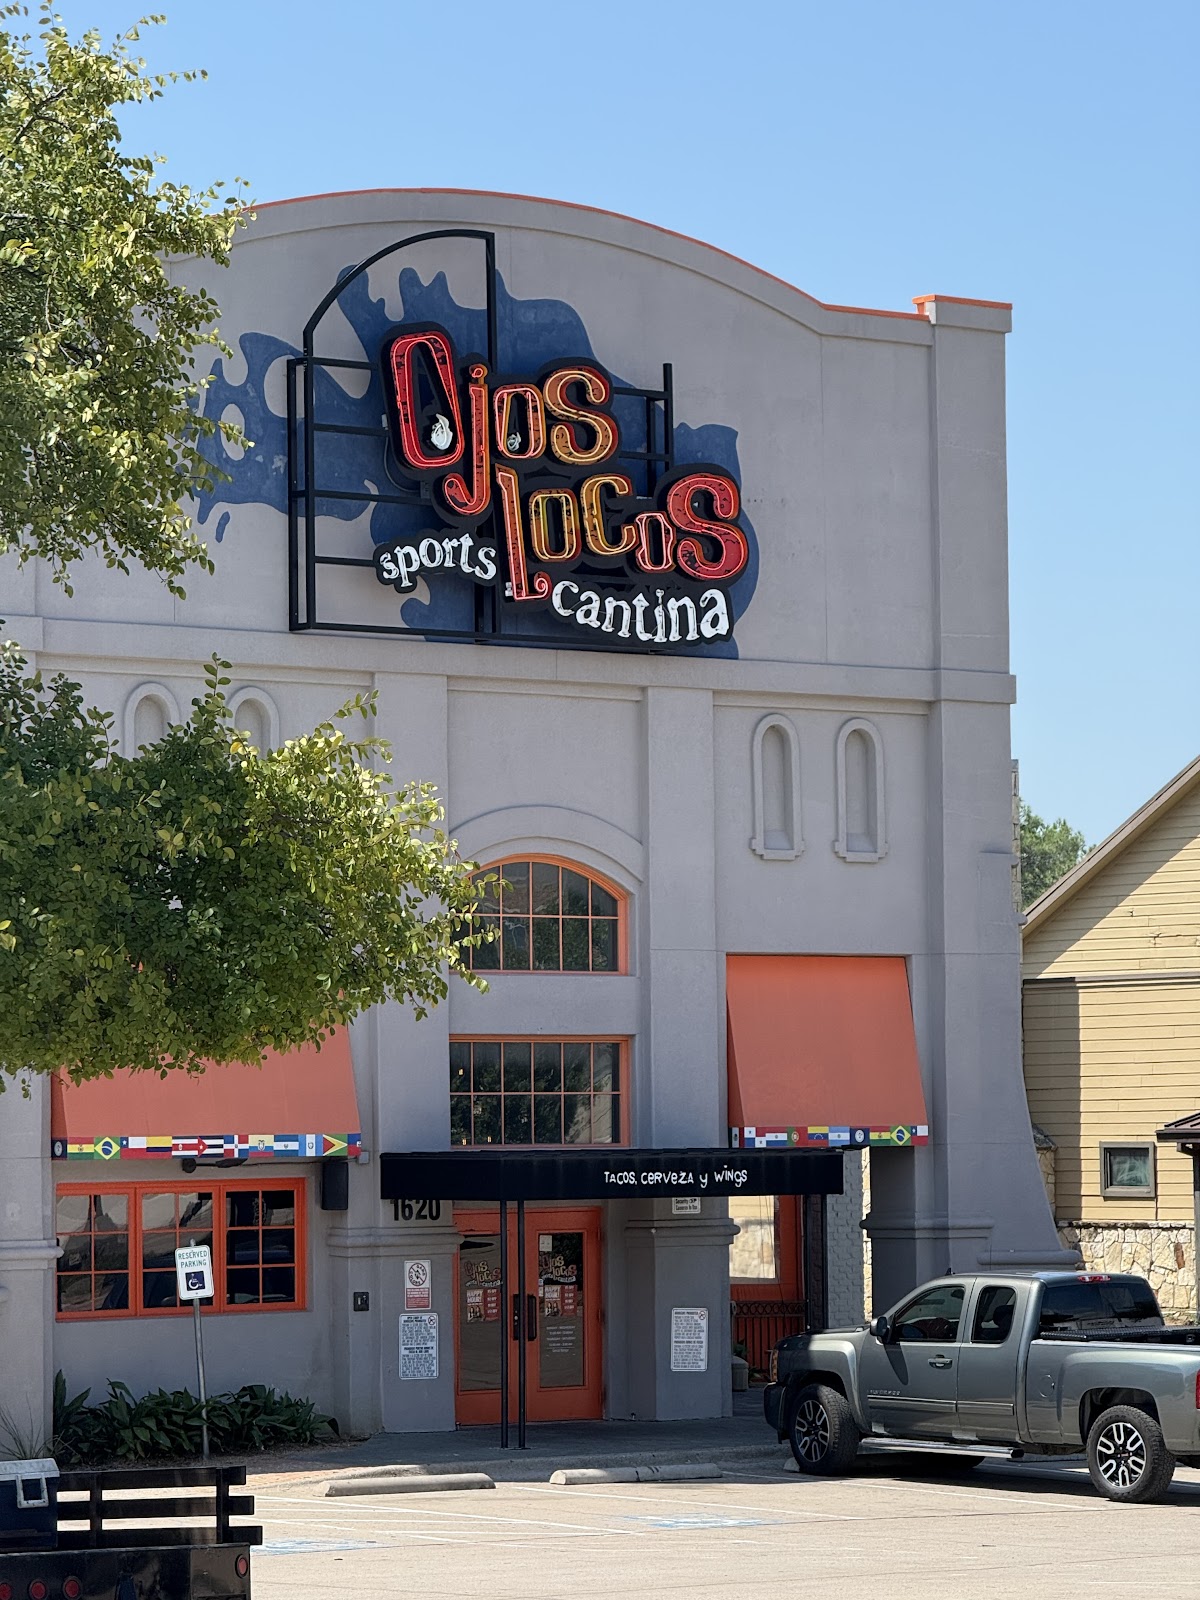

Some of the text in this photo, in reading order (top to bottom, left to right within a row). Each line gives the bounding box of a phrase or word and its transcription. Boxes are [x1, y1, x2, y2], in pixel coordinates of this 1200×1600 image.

[390, 330, 619, 516] Ojos
[378, 533, 497, 588] sports
[551, 580, 729, 643] cantina
[390, 1199, 441, 1222] 1620
[178, 1251, 207, 1259] RESERVED
[181, 1260, 206, 1268] PARKING
